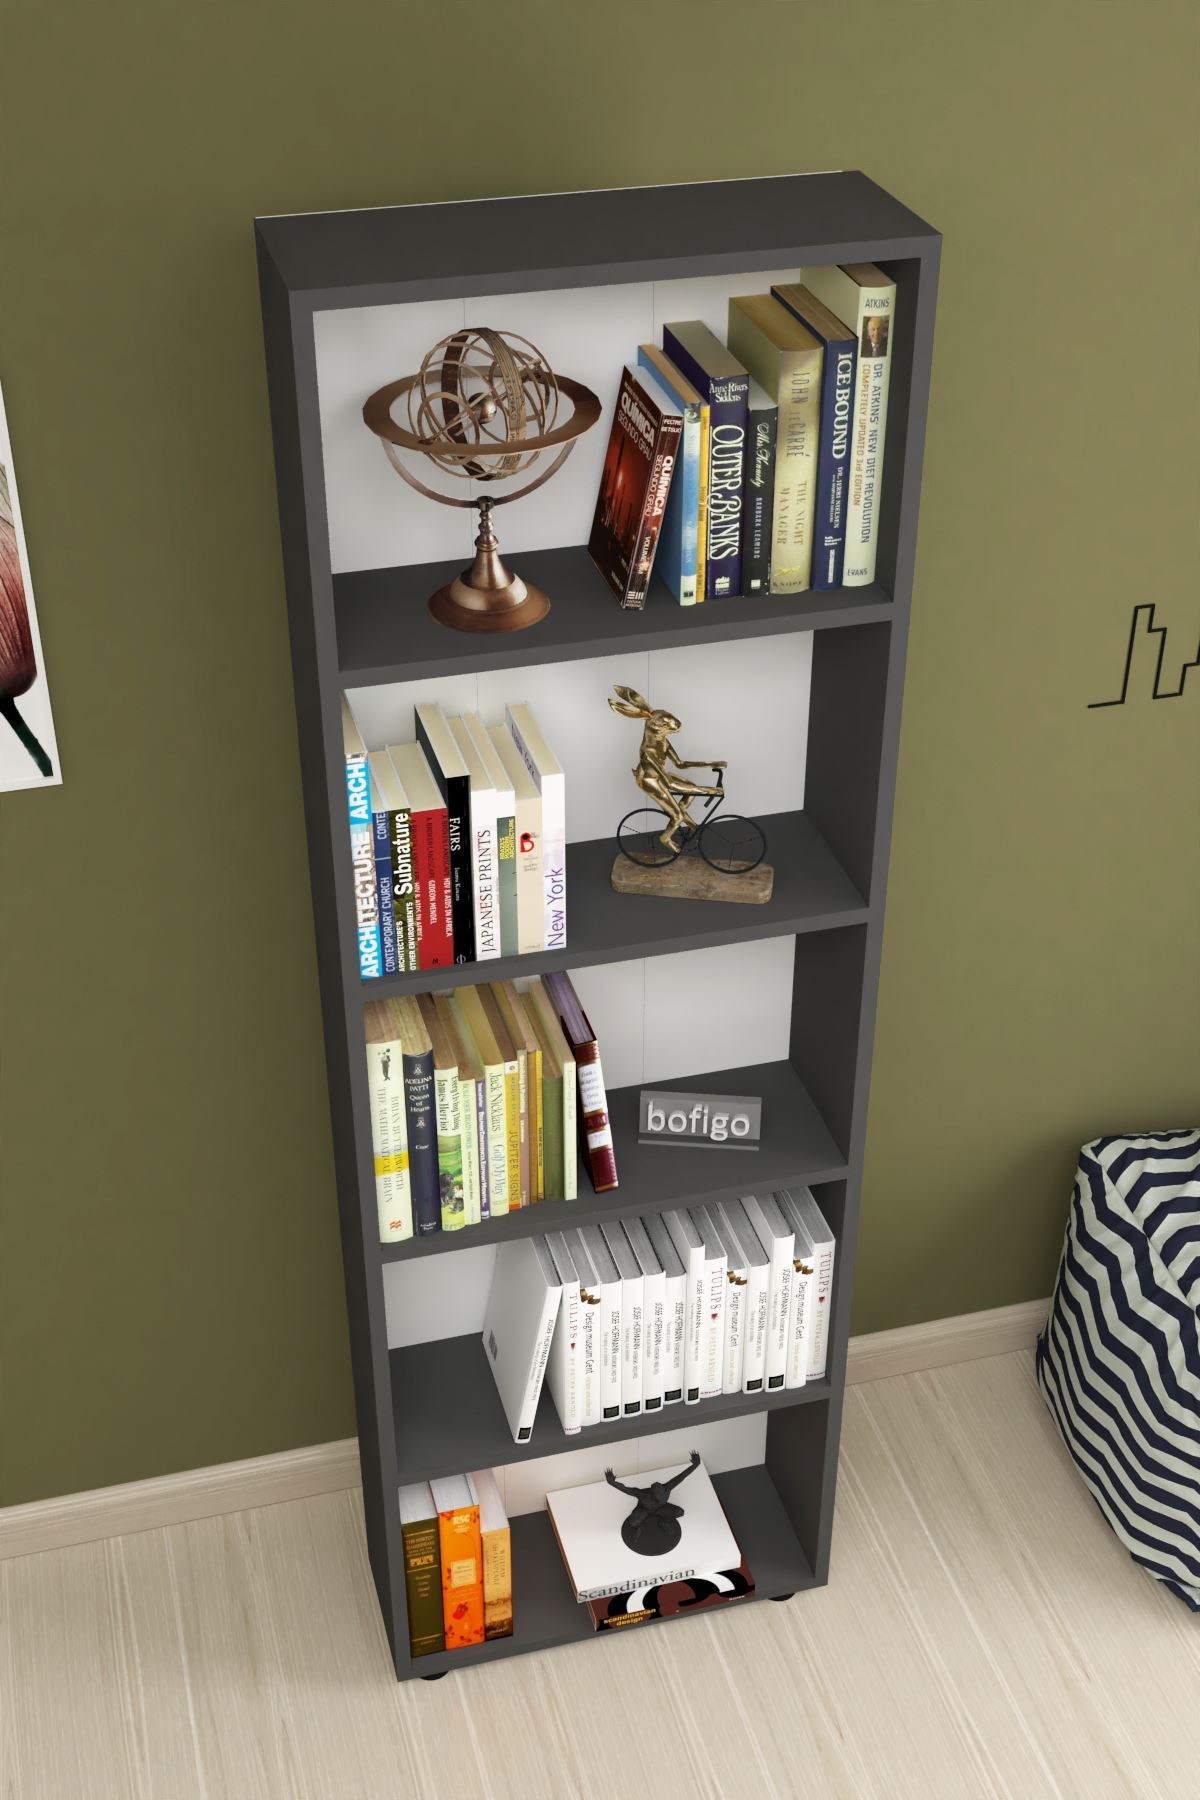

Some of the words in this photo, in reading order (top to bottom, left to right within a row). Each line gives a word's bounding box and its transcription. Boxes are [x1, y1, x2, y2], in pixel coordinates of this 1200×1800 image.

[865, 298, 890, 309] ATKINS
[837, 352, 852, 386] ICE
[873, 364, 882, 381] DR.
[791, 372, 810, 404] JOHN
[860, 364, 870, 415] COMPLETELY
[832, 387, 850, 459] BOUND
[856, 419, 866, 456] UPDATED
[868, 430, 878, 453] NEW
[650, 454, 664, 492] SEGUNDO
[712, 425, 744, 494] OUTER
[750, 448, 770, 488] Kennedy
[866, 458, 876, 479] DIET
[652, 455, 674, 518] QUÍMICA
[853, 474, 862, 506] EDITION
[645, 492, 654, 518] GRAU
[754, 497, 762, 528] BARBARA
[777, 488, 790, 546] MANAGER
[861, 483, 874, 544] REVOLUTION
[706, 492, 742, 560] BANKS
[792, 510, 806, 546] NIGHT
[450, 817, 460, 851] FAIRS
[394, 812, 413, 895] Subnature
[478, 830, 492, 881] PRINTS
[380, 877, 391, 910] CHURCH
[545, 868, 564, 905] York
[352, 831, 380, 977] ARCHITECTURE
[480, 884, 497, 952] JAPANESE
[382, 911, 396, 972] CONTEMPORARY
[406, 901, 415, 950] ENVIRONMENTS
[548, 910, 564, 946] New
[408, 950, 416, 971] OTHER
[378, 1088, 386, 1104] THE
[410, 1092, 430, 1102] Queen
[437, 1079, 448, 1102] James
[490, 1074, 502, 1092] Jack
[391, 1096, 401, 1123] BRIAN
[439, 1103, 450, 1131] Herriot
[451, 1093, 459, 1112] Living
[490, 1095, 504, 1132] Nicklaus
[452, 1112, 460, 1130] Thing
[648, 1100, 750, 1142] bofigo
[379, 1110, 390, 1175] MATHEMATICAL
[392, 1126, 404, 1190] BUTTERWORTH
[492, 1144, 505, 1162] Golf
[510, 1130, 520, 1170] JUPITER
[383, 1177, 393, 1203] BRAIN
[510, 1174, 520, 1202] SIGNS
[819, 1251, 832, 1294] TULIPS
[711, 1268, 722, 1310] TULIPS
[730, 1292, 740, 1310] Design
[796, 1281, 808, 1301] Design
[570, 1294, 578, 1339] TULIPS
[584, 1312, 595, 1334] Design
[797, 1302, 805, 1325] museum
[585, 1334, 593, 1359] museum
[730, 1334, 740, 1348] Gent
[796, 1326, 804, 1340] Gent
[585, 1359, 595, 1374] Gent
[578, 1569, 696, 1600] Scandinavian
[604, 1608, 656, 1624] scandinavian
[616, 1616, 644, 1626] design
